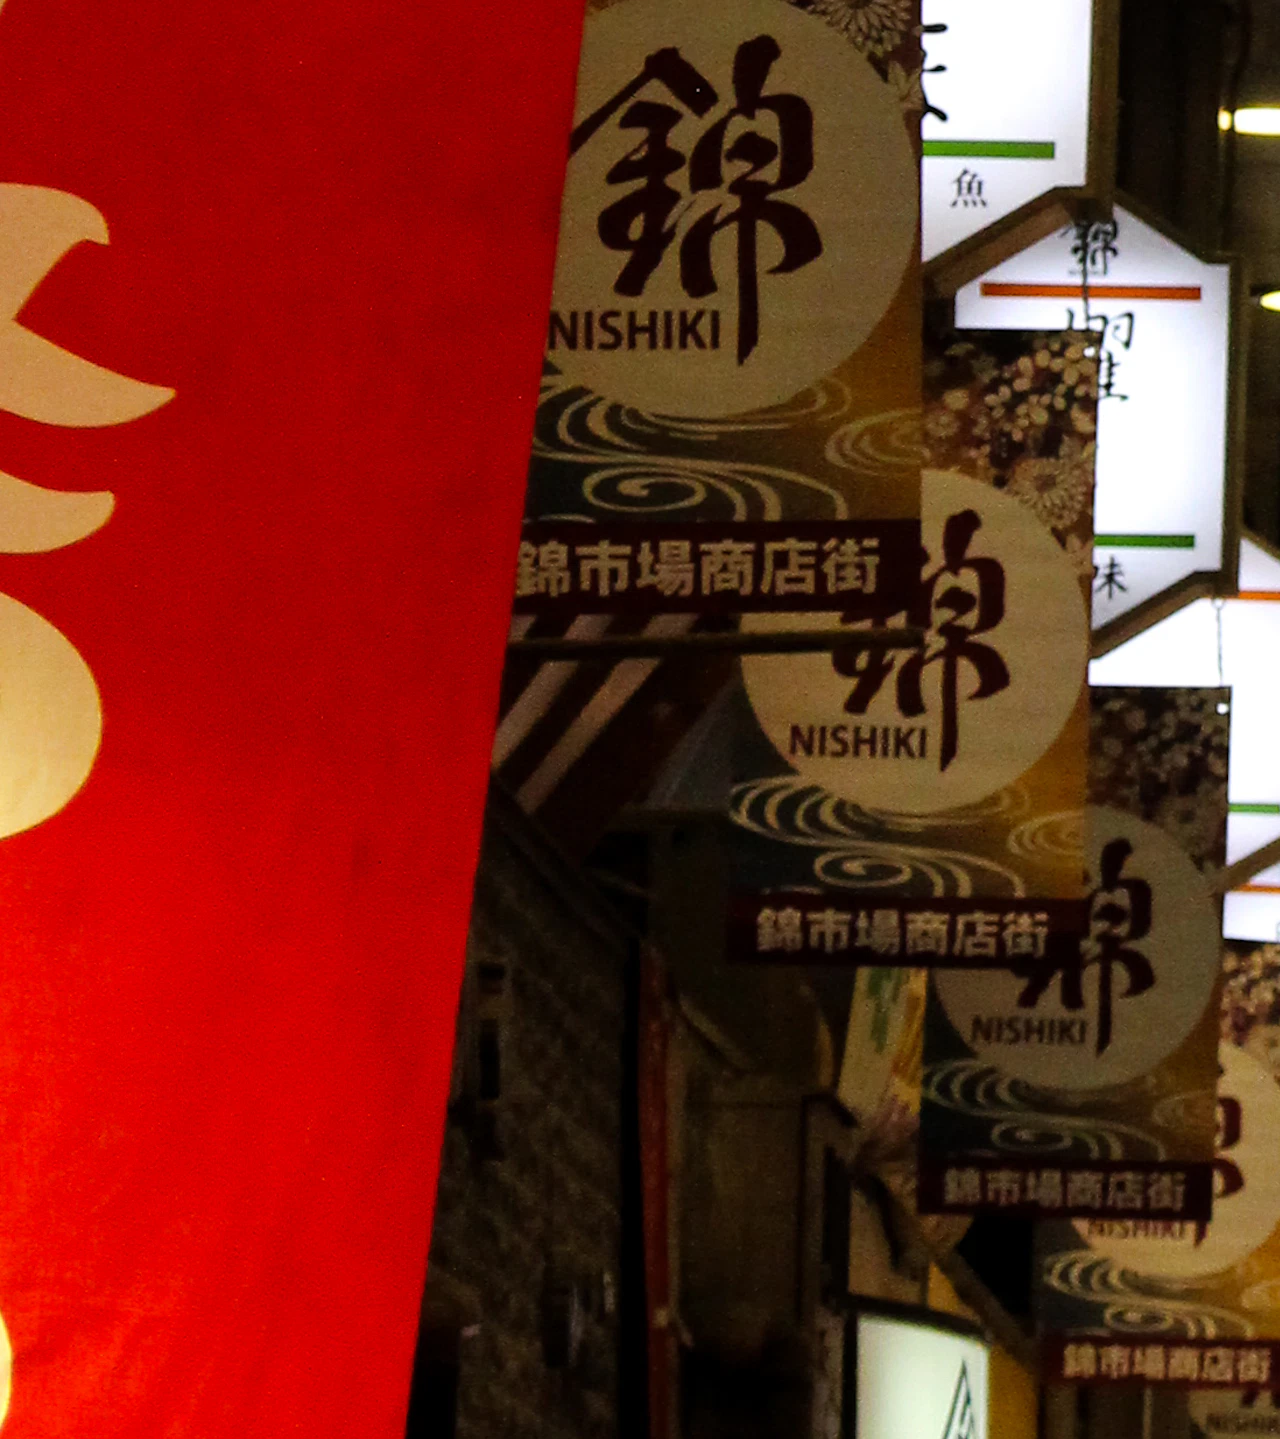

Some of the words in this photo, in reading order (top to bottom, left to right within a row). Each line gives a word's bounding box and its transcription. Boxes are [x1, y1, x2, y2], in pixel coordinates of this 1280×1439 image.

[569, 34, 824, 367] 錦
[547, 308, 722, 352] NISHIKI
[516, 538, 880, 598] 錦市場商店街
[789, 725, 927, 759] NISHIKI
[754, 904, 1049, 958] 錦市場商店街
[971, 1017, 1086, 1047] NISHIKI
